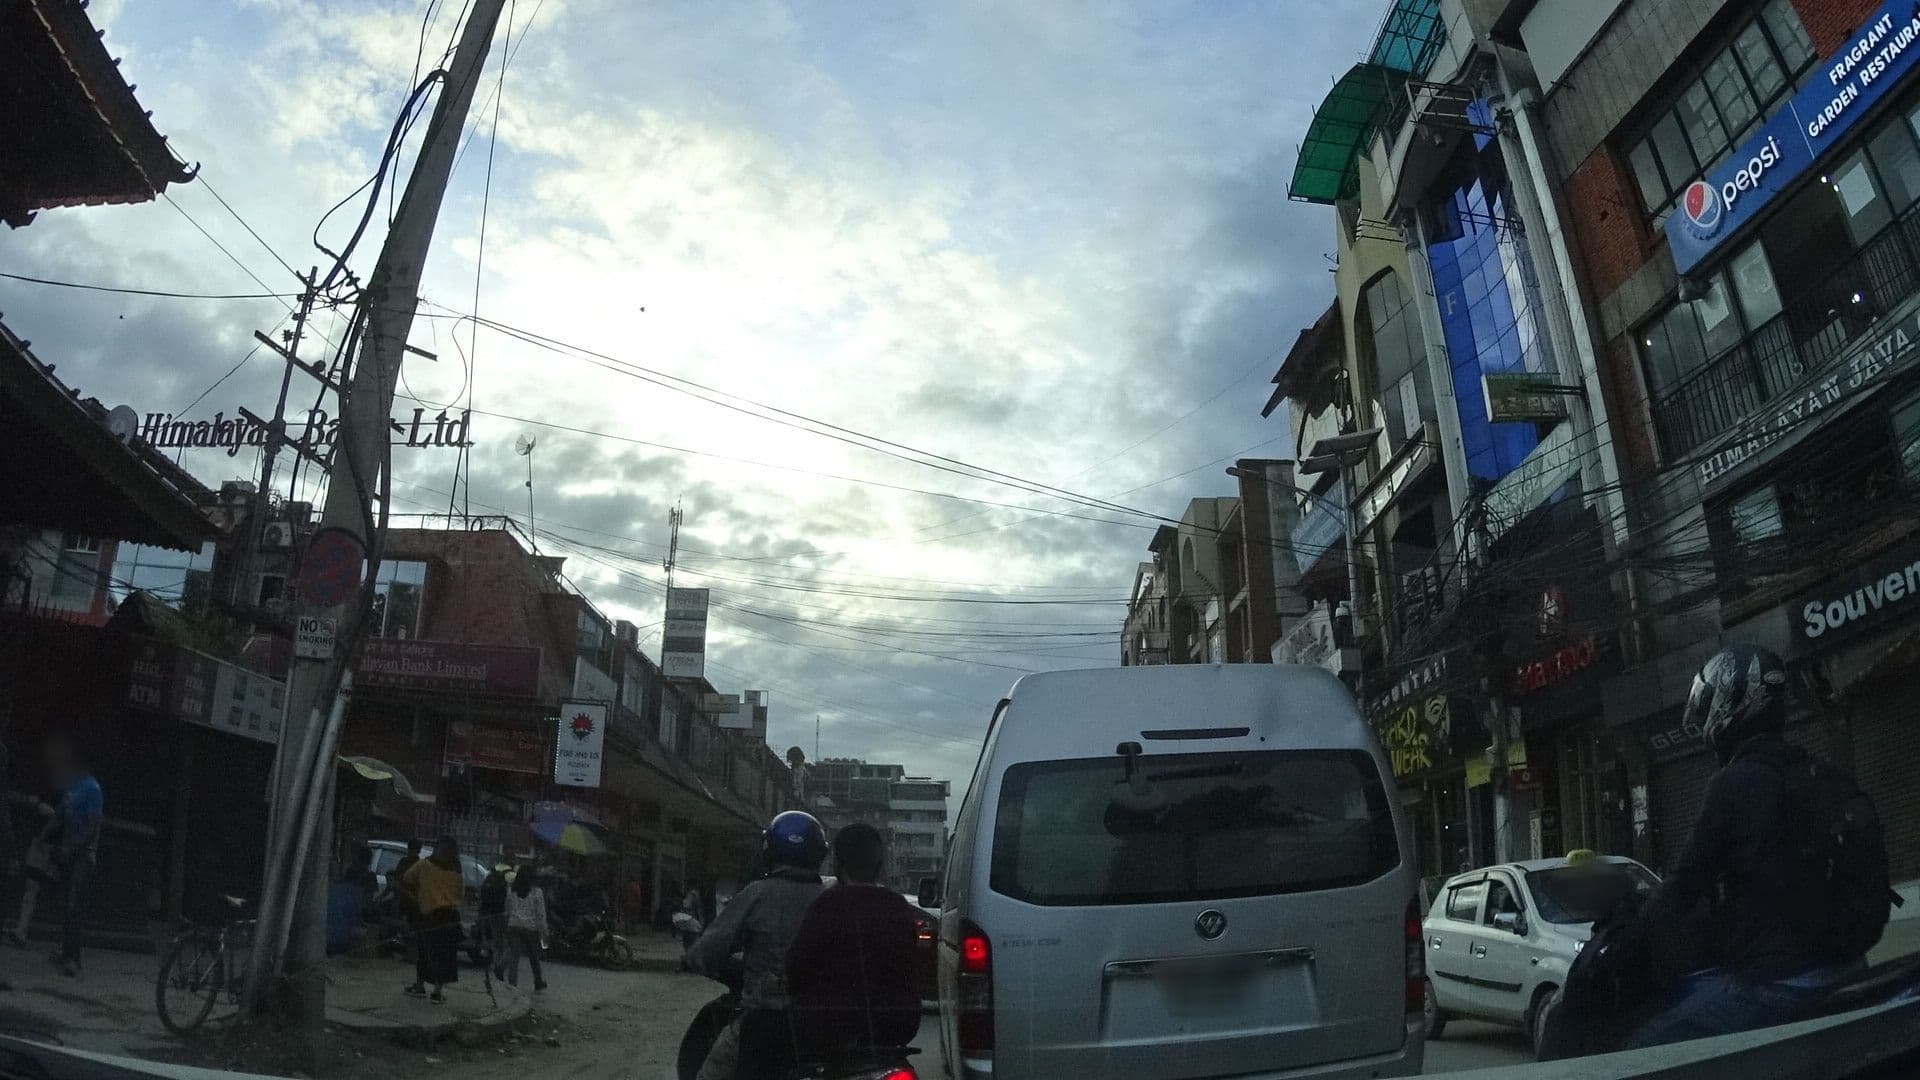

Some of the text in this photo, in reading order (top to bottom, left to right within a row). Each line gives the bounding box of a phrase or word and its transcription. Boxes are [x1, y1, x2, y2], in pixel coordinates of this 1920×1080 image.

[1808, 12, 1920, 137] GARDEN RESTAURA
[1828, 12, 1893, 86] FRAGRANT
[1722, 135, 1780, 211] pepsi
[142, 411, 266, 457] Himalaya
[1700, 328, 1917, 486] HIMALAYAN JAVA
[300, 618, 318, 633] NO
[129, 683, 161, 708] ATM
[401, 656, 434, 673] Bank
[436, 659, 487, 677] Limited
